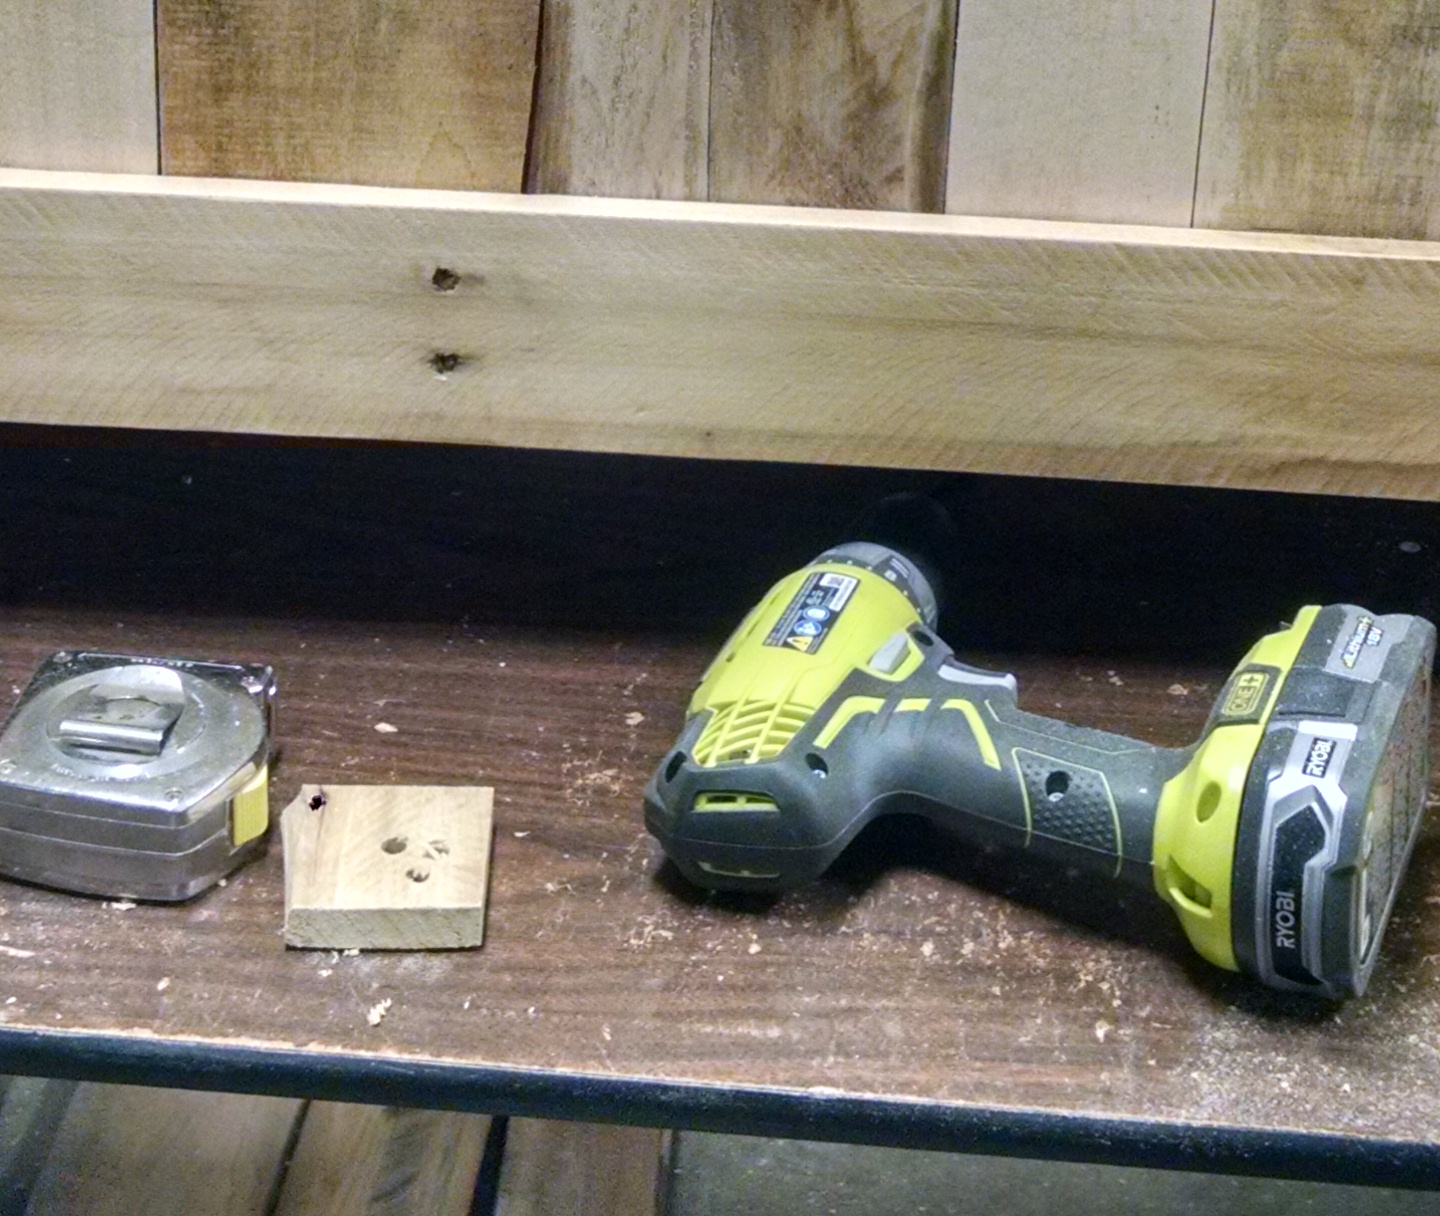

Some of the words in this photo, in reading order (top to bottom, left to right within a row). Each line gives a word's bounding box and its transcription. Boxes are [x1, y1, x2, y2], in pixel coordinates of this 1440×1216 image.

[1366, 626, 1383, 647] 18V
[1305, 738, 1334, 777] RYOBI
[1276, 891, 1296, 949] RYOBI
